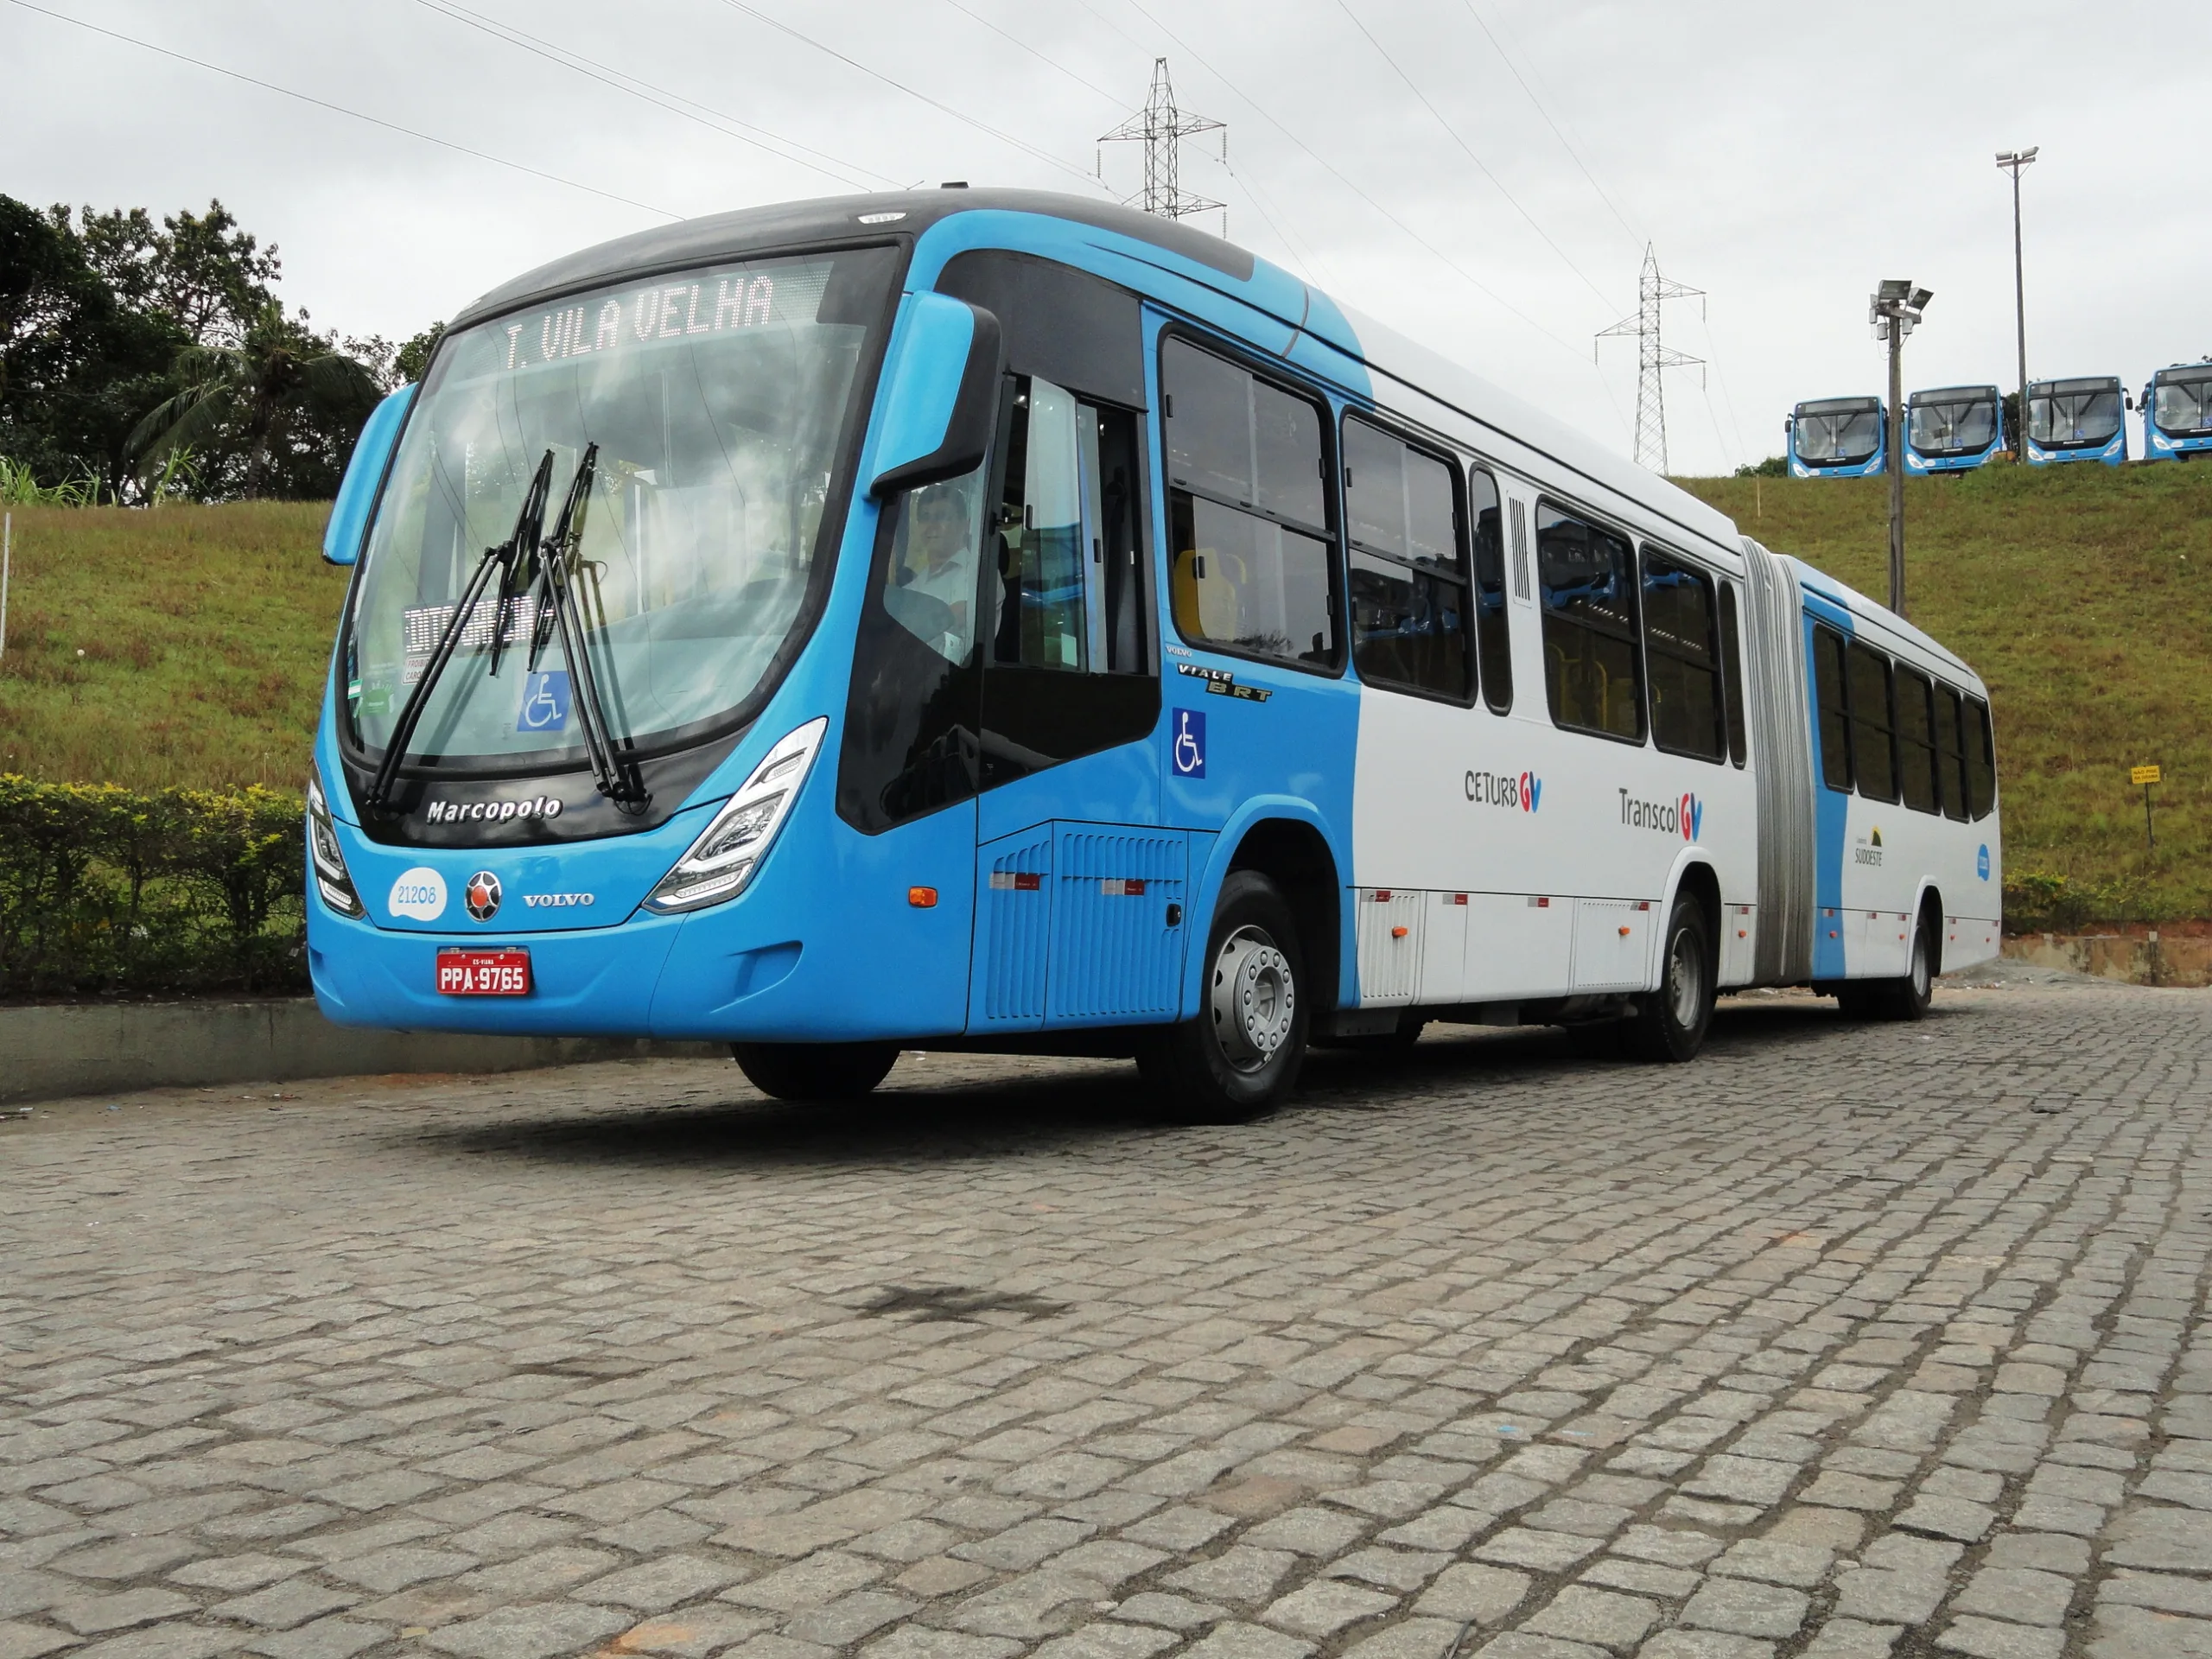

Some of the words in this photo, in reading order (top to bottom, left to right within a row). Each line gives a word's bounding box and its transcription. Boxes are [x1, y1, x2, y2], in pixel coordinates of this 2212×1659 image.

[507, 324, 527, 369] T.
[541, 300, 620, 360] VILA
[634, 276, 773, 341] VELHA
[1166, 645, 1192, 658] VOLVO
[1179, 664, 1233, 682] VIALE
[1208, 681, 1271, 701] BRT
[1465, 770, 1517, 807] CETURB
[426, 796, 563, 825] Marcopolo
[1618, 787, 1679, 834] Transcol
[1855, 848, 1882, 867] SUDOESTE
[397, 887, 436, 905] 21208
[523, 893, 595, 908] VOLVO
